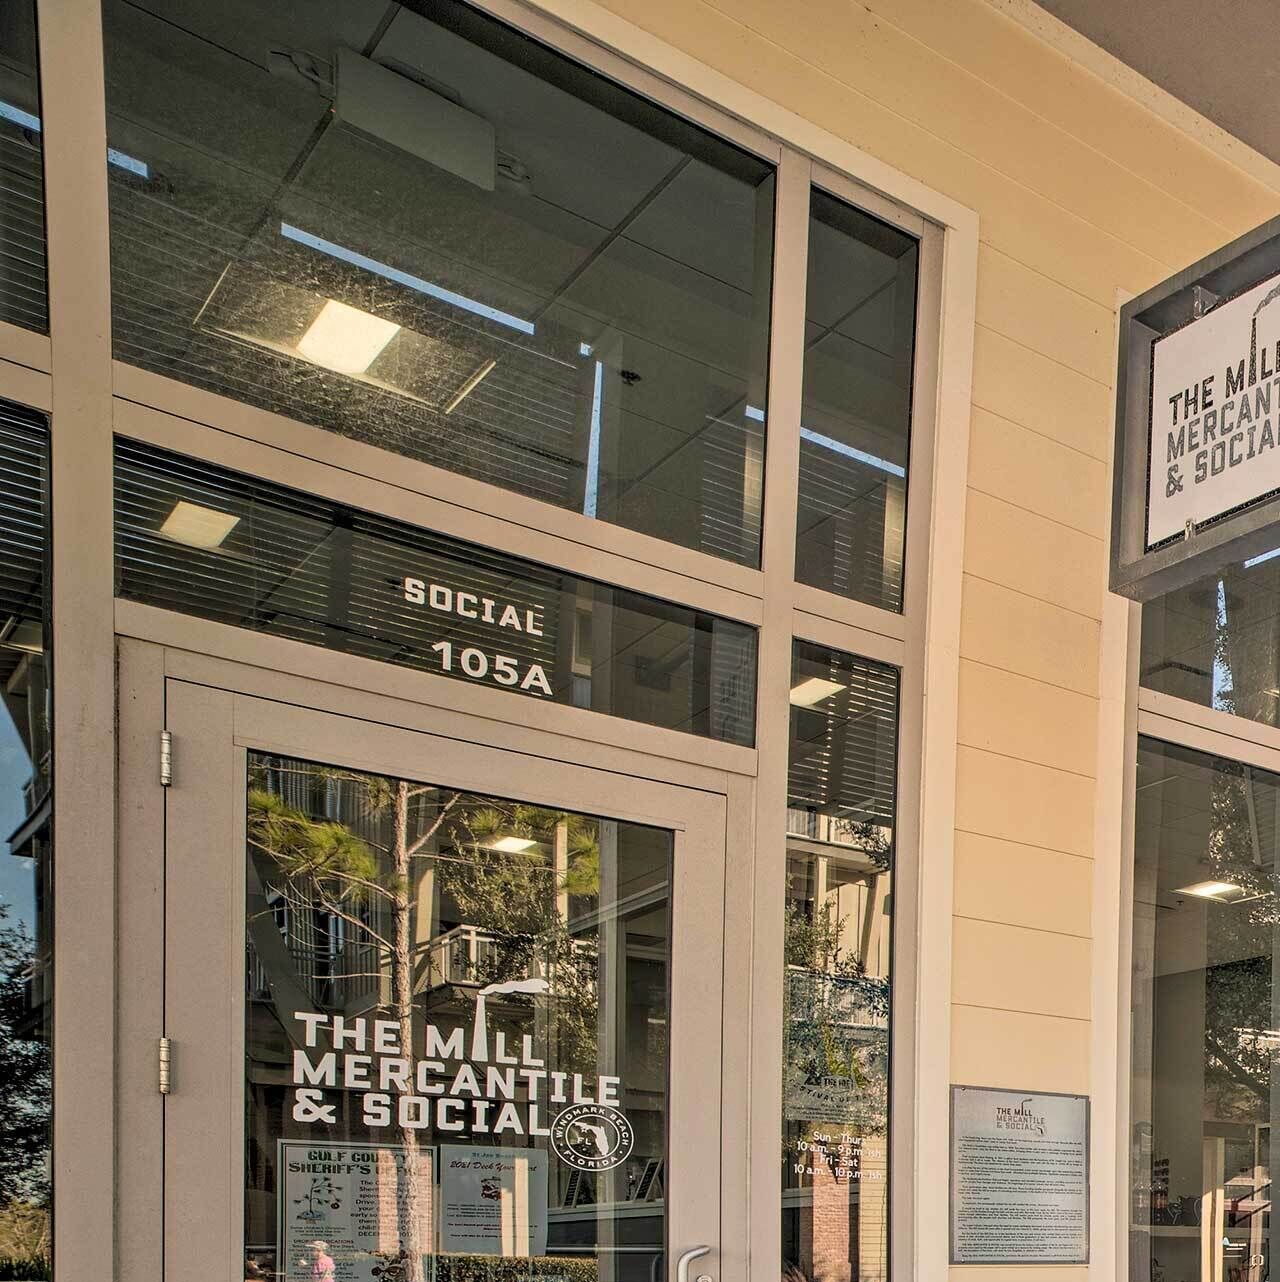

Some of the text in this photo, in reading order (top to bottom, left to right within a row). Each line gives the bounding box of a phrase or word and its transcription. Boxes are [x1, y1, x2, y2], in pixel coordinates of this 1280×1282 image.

[1169, 375, 1214, 425] THE
[1165, 464, 1183, 498] &
[404, 577, 543, 636] SOCIAL
[432, 641, 553, 695] 105A
[295, 994, 544, 1067] THE MILL
[293, 1049, 620, 1107] MERCANTILE
[293, 1089, 550, 1137] & SOCIAL
[997, 1103, 1032, 1116] THE MILL
[556, 1106, 629, 1146] WINDMARK BEACH
[996, 1115, 1044, 1124] MERCANTILE
[1006, 1123, 1036, 1131] SOCIAL
[813, 1131, 831, 1142] Sun
[307, 1150, 346, 1162] GULF
[797, 1141, 807, 1151] 10
[837, 1145, 844, 1155] 9
[564, 1150, 618, 1168] FLORIDA
[842, 1157, 858, 1167] Sat
[289, 1162, 371, 1175] SHERIFF'S
[794, 1164, 804, 1174] 10
[835, 1167, 844, 1177] 10
